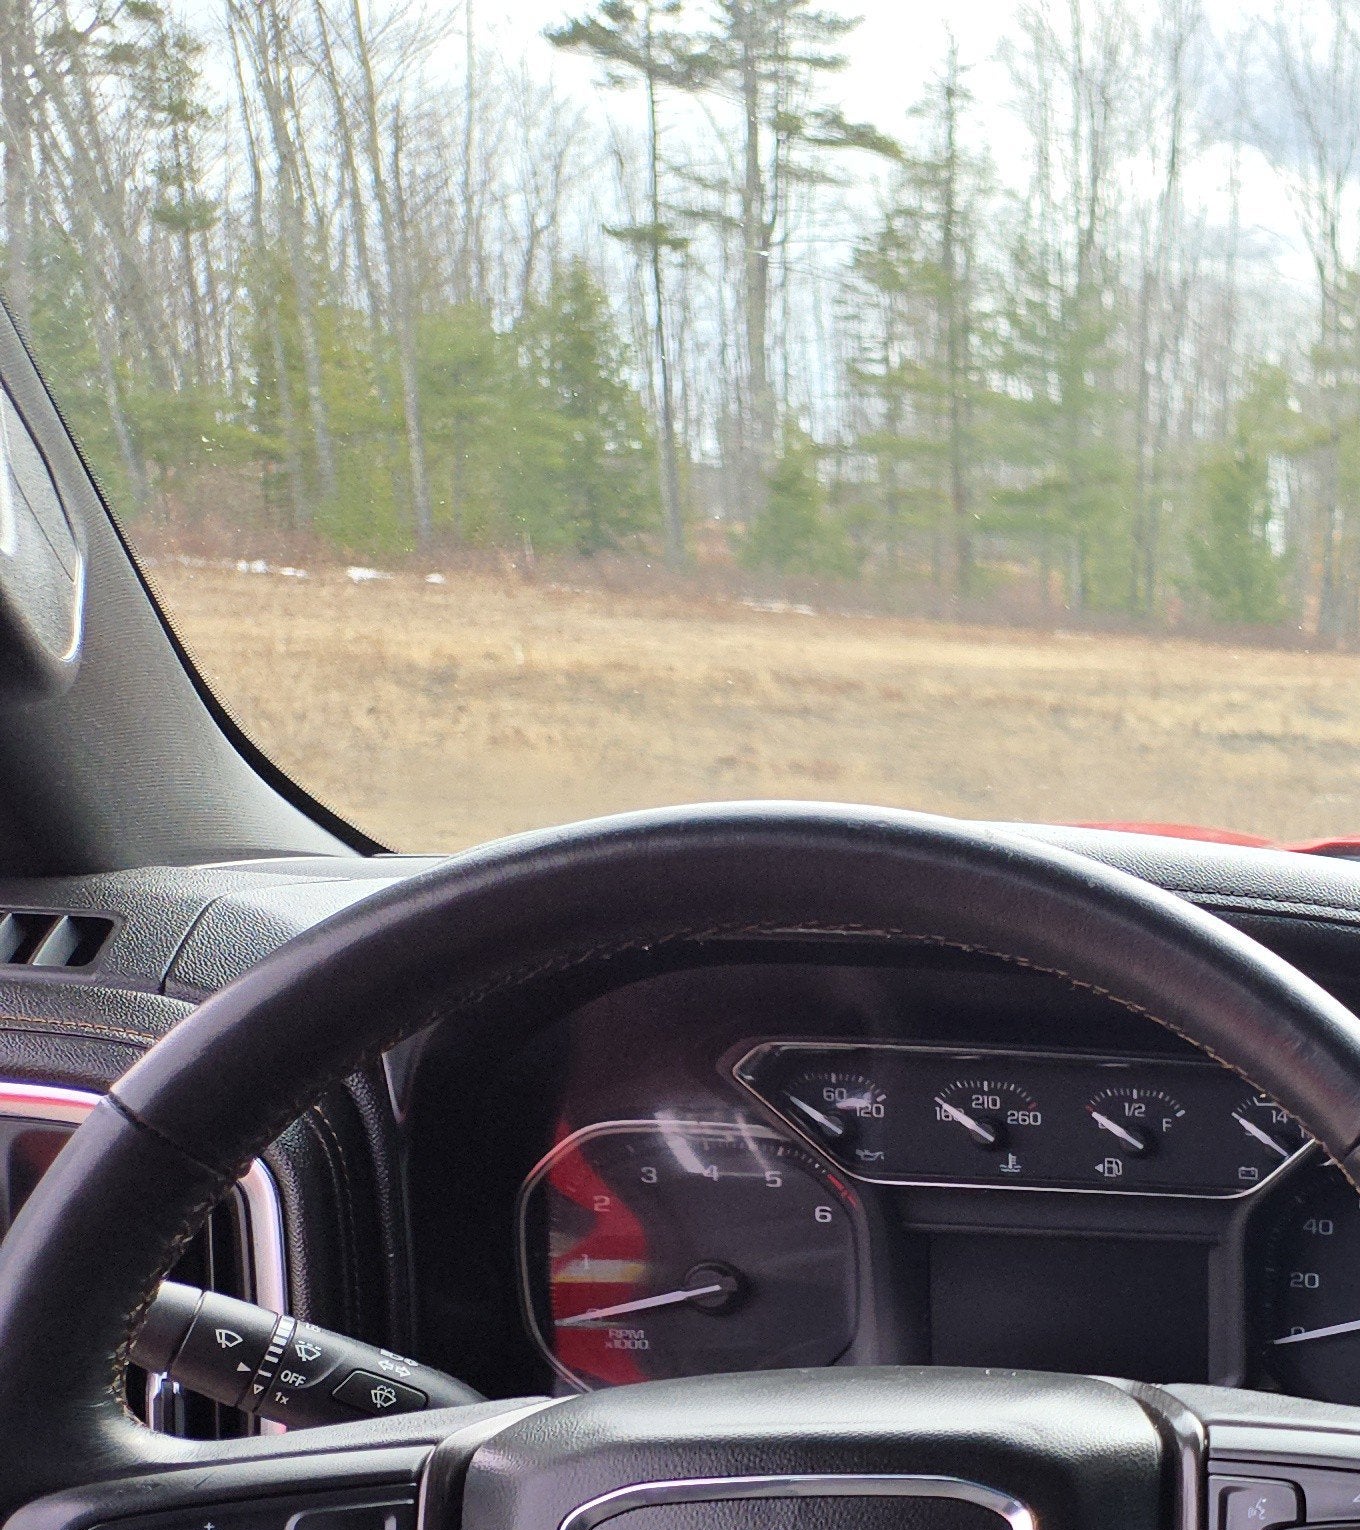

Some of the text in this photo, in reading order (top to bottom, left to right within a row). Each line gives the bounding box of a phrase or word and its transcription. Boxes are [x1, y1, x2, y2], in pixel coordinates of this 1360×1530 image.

[823, 1087, 847, 1100] 60
[972, 1094, 1000, 1110] 210
[1123, 1102, 1146, 1118] 1/2
[855, 1104, 885, 1118] 120
[1006, 1110, 1042, 1126] 260
[1162, 1119, 1173, 1132] F
[640, 1166, 658, 1184] 3
[702, 1165, 720, 1182] 4
[764, 1170, 783, 1188] 5
[593, 1195, 611, 1212] 2
[814, 1205, 833, 1223] 6
[1303, 1219, 1334, 1235] 40
[1289, 1272, 1320, 1289] 20
[280, 1369, 307, 1387] OFF
[274, 1391, 290, 1405] 1x
